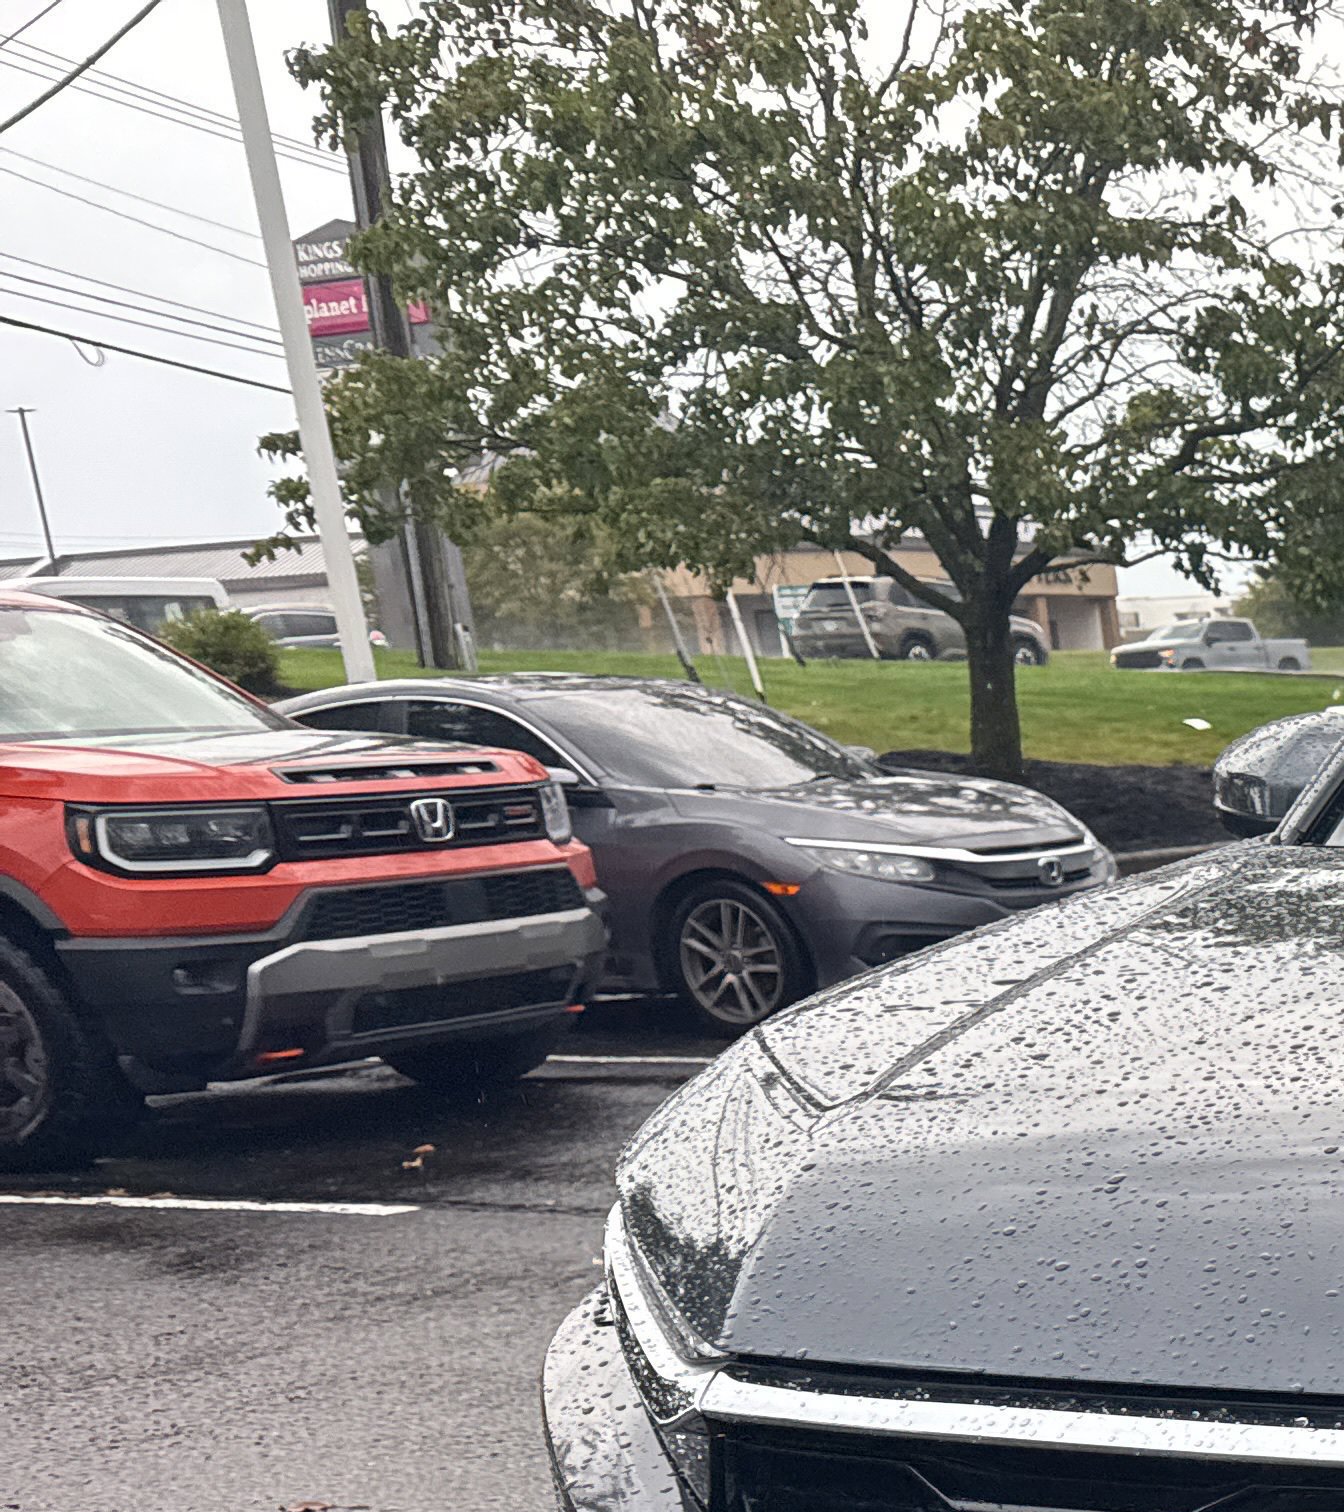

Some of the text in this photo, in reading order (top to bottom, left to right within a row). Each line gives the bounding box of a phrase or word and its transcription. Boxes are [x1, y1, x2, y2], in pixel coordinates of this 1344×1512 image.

[296, 241, 343, 261] KINGS
[298, 260, 354, 278] HOPPING
[304, 296, 357, 325] planet
